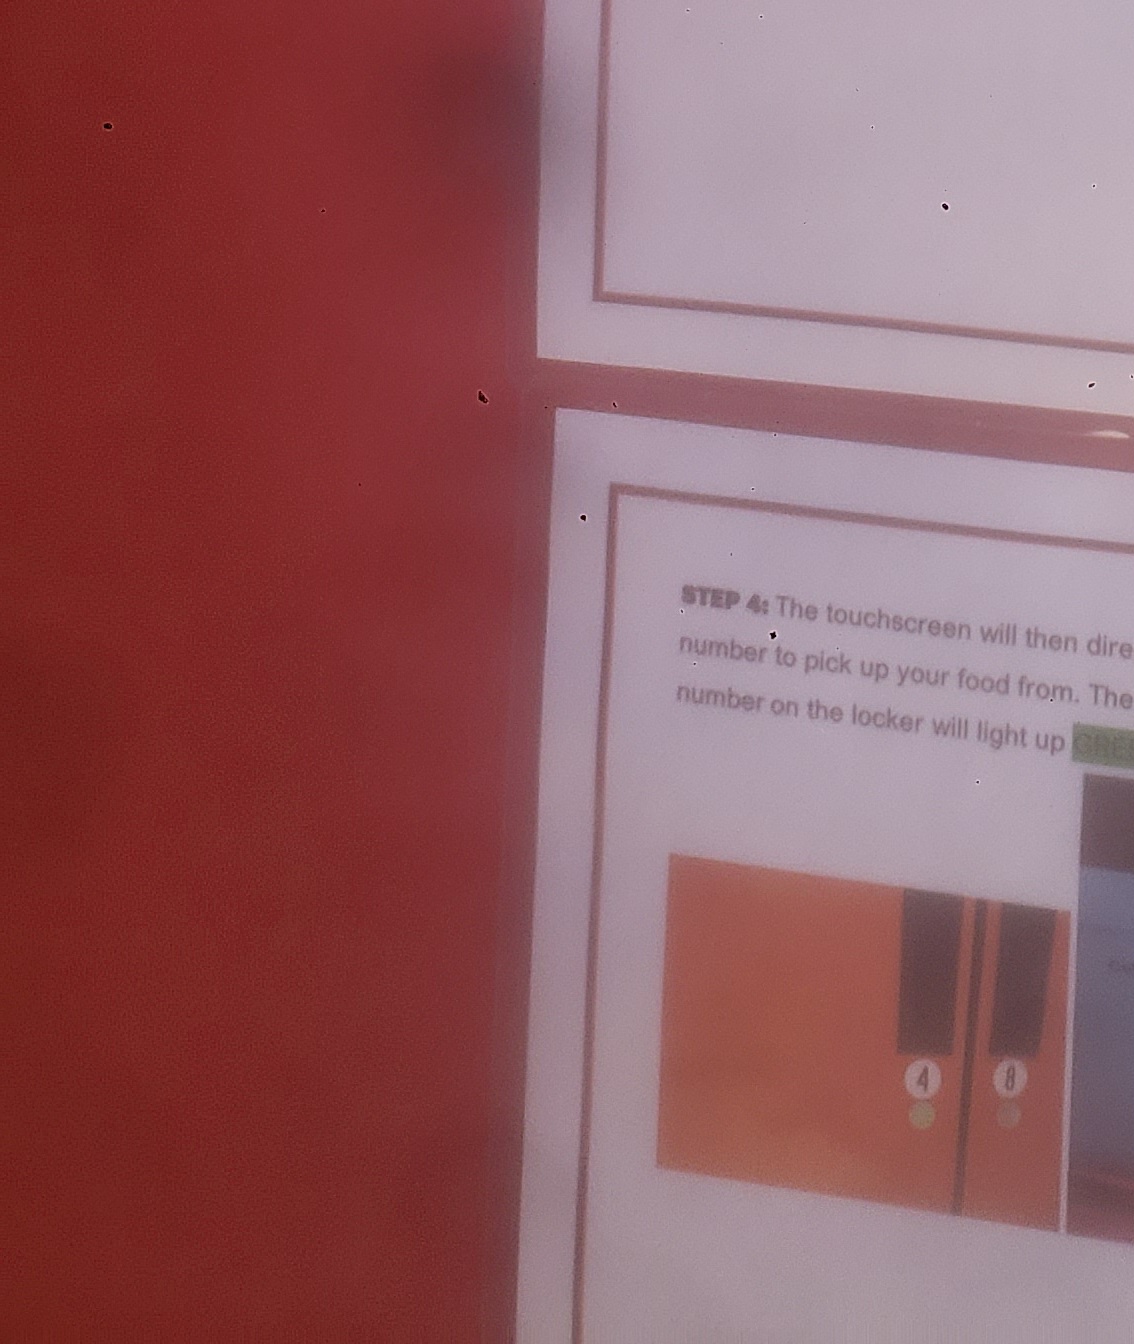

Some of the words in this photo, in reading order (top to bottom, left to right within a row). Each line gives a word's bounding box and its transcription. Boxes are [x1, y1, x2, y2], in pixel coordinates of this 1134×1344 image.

[681, 584, 741, 610] STEP
[745, 593, 770, 615] 4:
[775, 594, 819, 623] The
[825, 603, 972, 640] touchscreen
[979, 624, 1018, 646] will
[1024, 627, 1079, 653] then
[678, 635, 768, 663] number
[774, 645, 798, 669] to
[803, 651, 852, 675] pick
[859, 660, 890, 684] up
[896, 666, 950, 688] your
[956, 667, 1011, 696] food
[1016, 674, 1079, 704] from.
[1089, 683, 1134, 711] The
[675, 684, 765, 713] number
[769, 698, 800, 717] on
[806, 699, 845, 724] the
[851, 704, 924, 734] locker
[931, 717, 969, 740] will
[976, 720, 1028, 751] light
[1034, 733, 1067, 756] up
